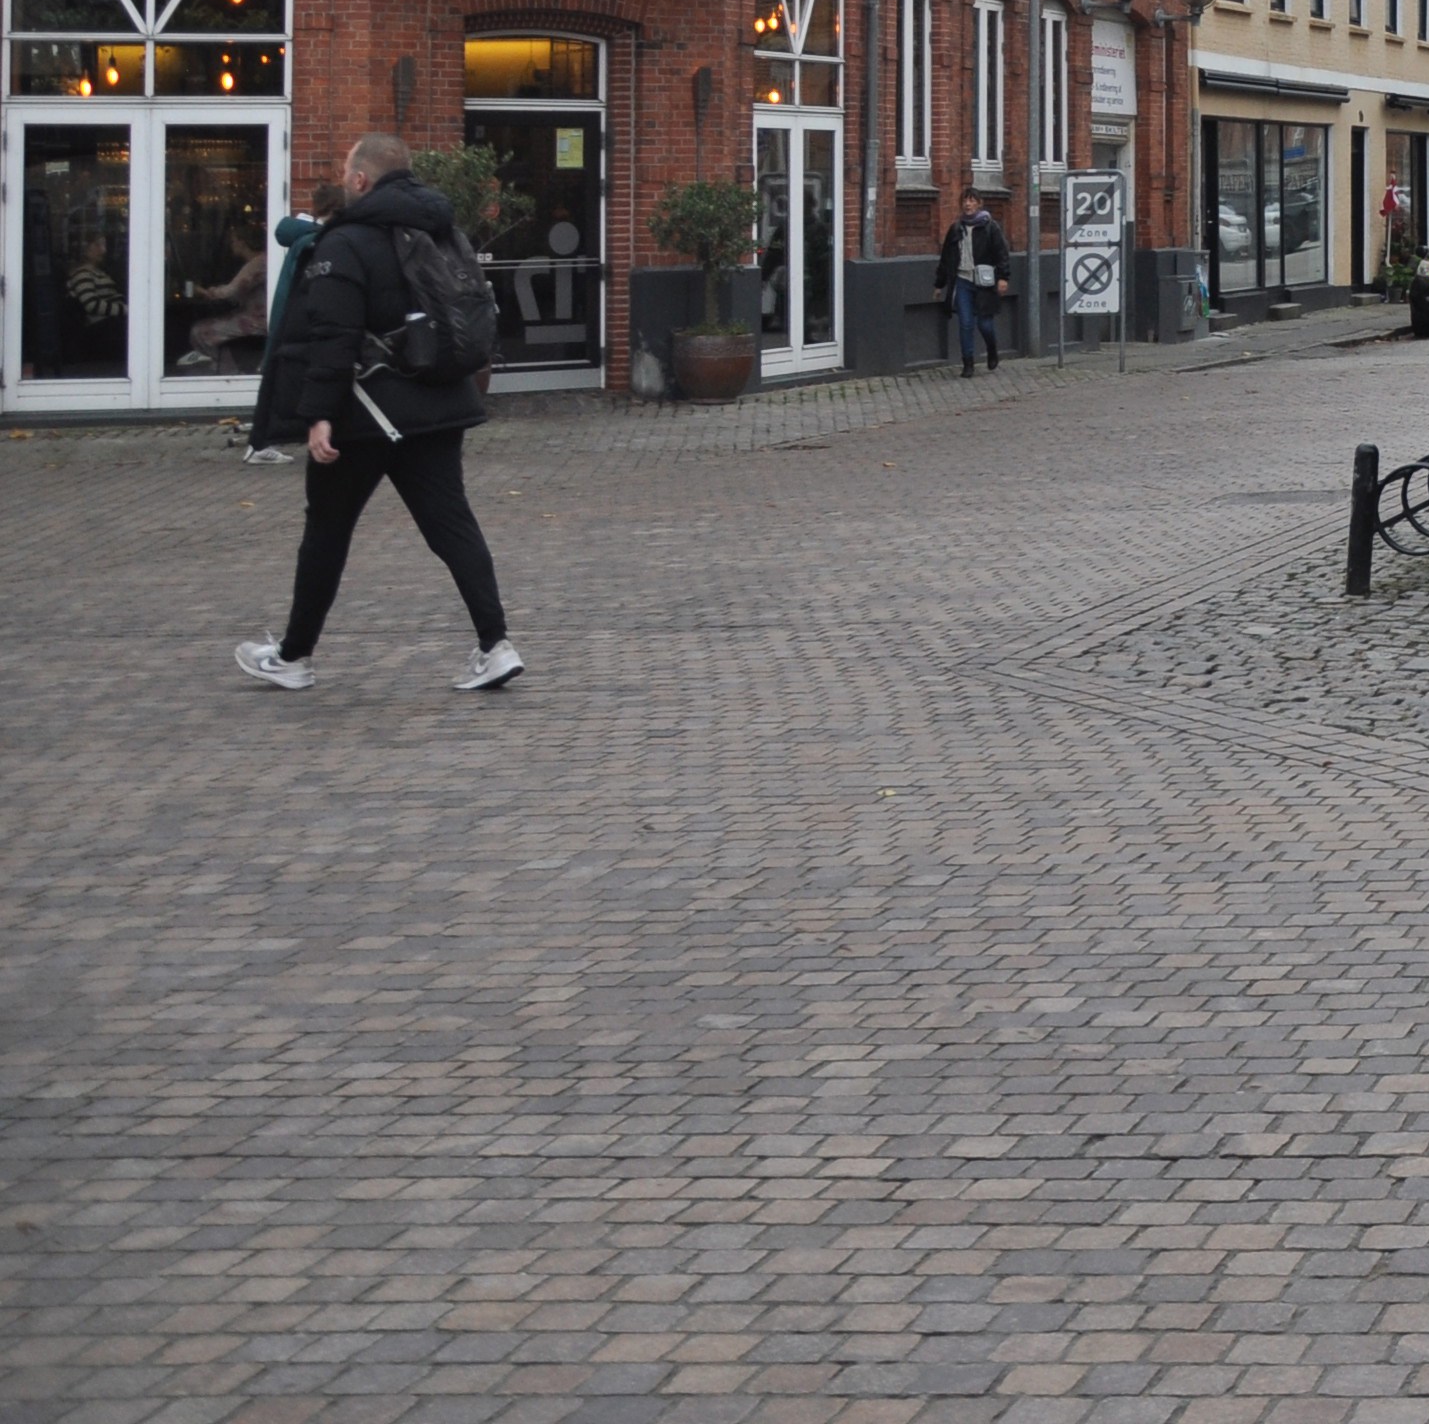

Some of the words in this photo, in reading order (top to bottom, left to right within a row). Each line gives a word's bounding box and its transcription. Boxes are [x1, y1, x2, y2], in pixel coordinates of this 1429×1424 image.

[1076, 192, 1112, 215] 20
[1078, 228, 1108, 237] Zone
[1078, 300, 1107, 308] Zone
